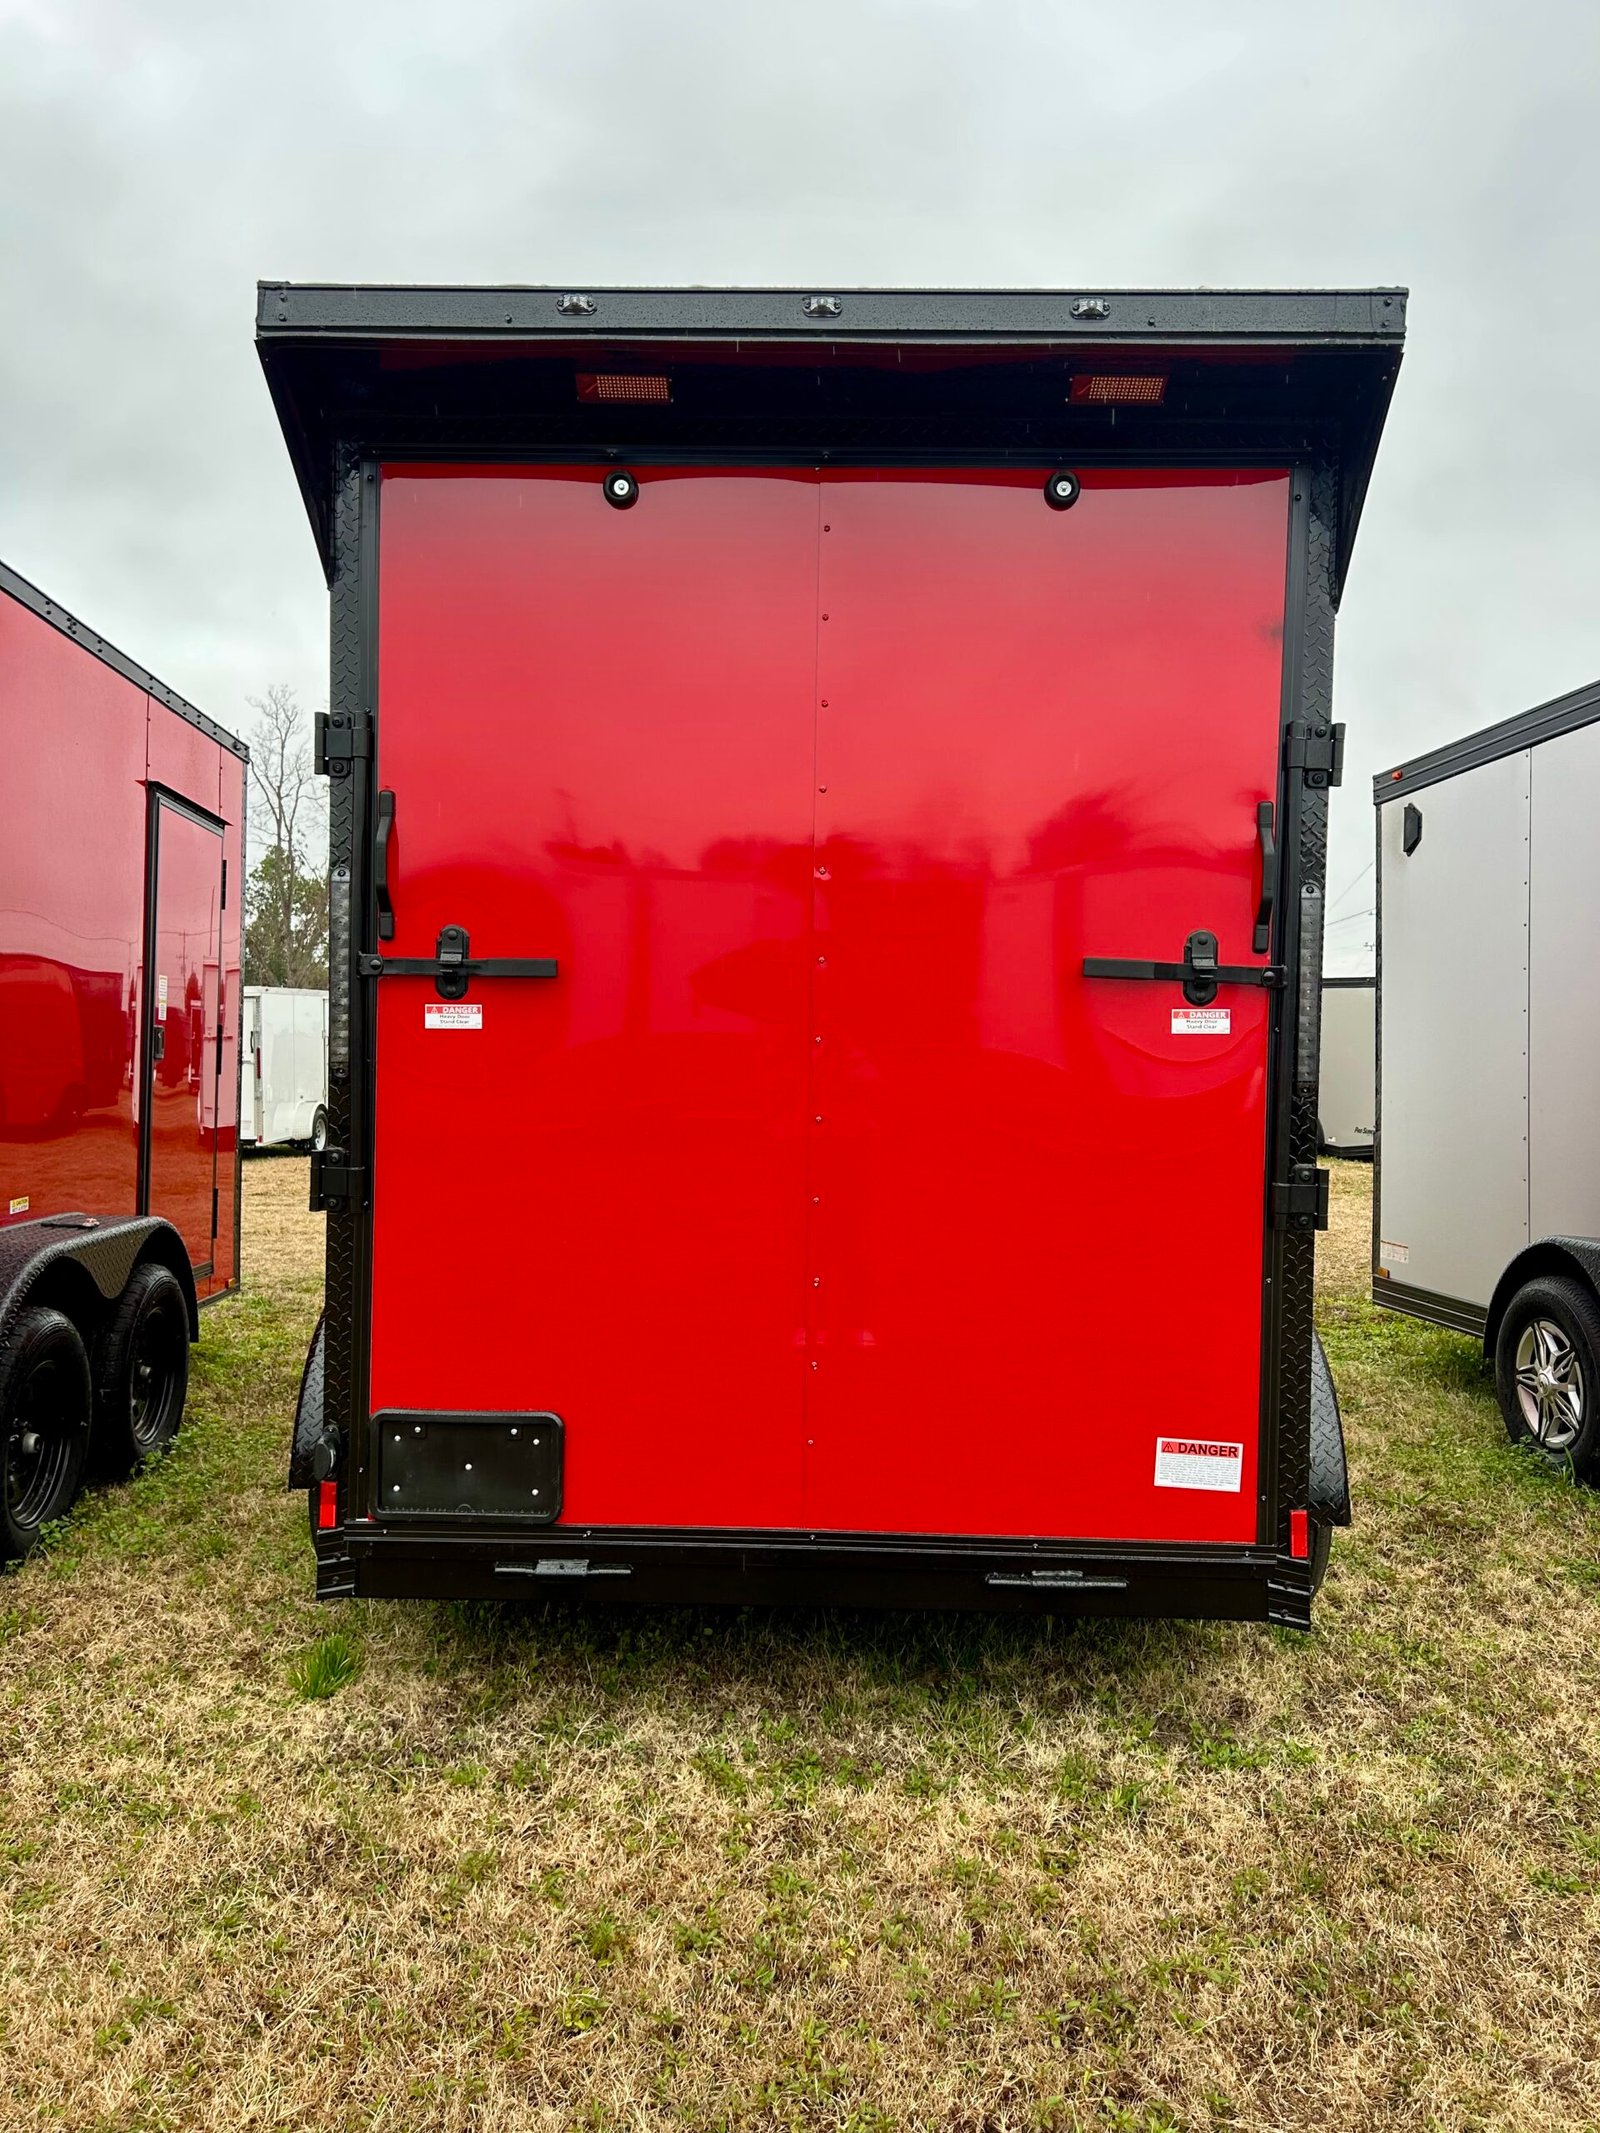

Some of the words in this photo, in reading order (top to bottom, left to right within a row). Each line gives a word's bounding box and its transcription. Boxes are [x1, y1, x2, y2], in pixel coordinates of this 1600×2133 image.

[442, 1006, 478, 1014] DANGER
[1190, 1011, 1226, 1019] DANGER
[1178, 1442, 1238, 1457] DANGER
